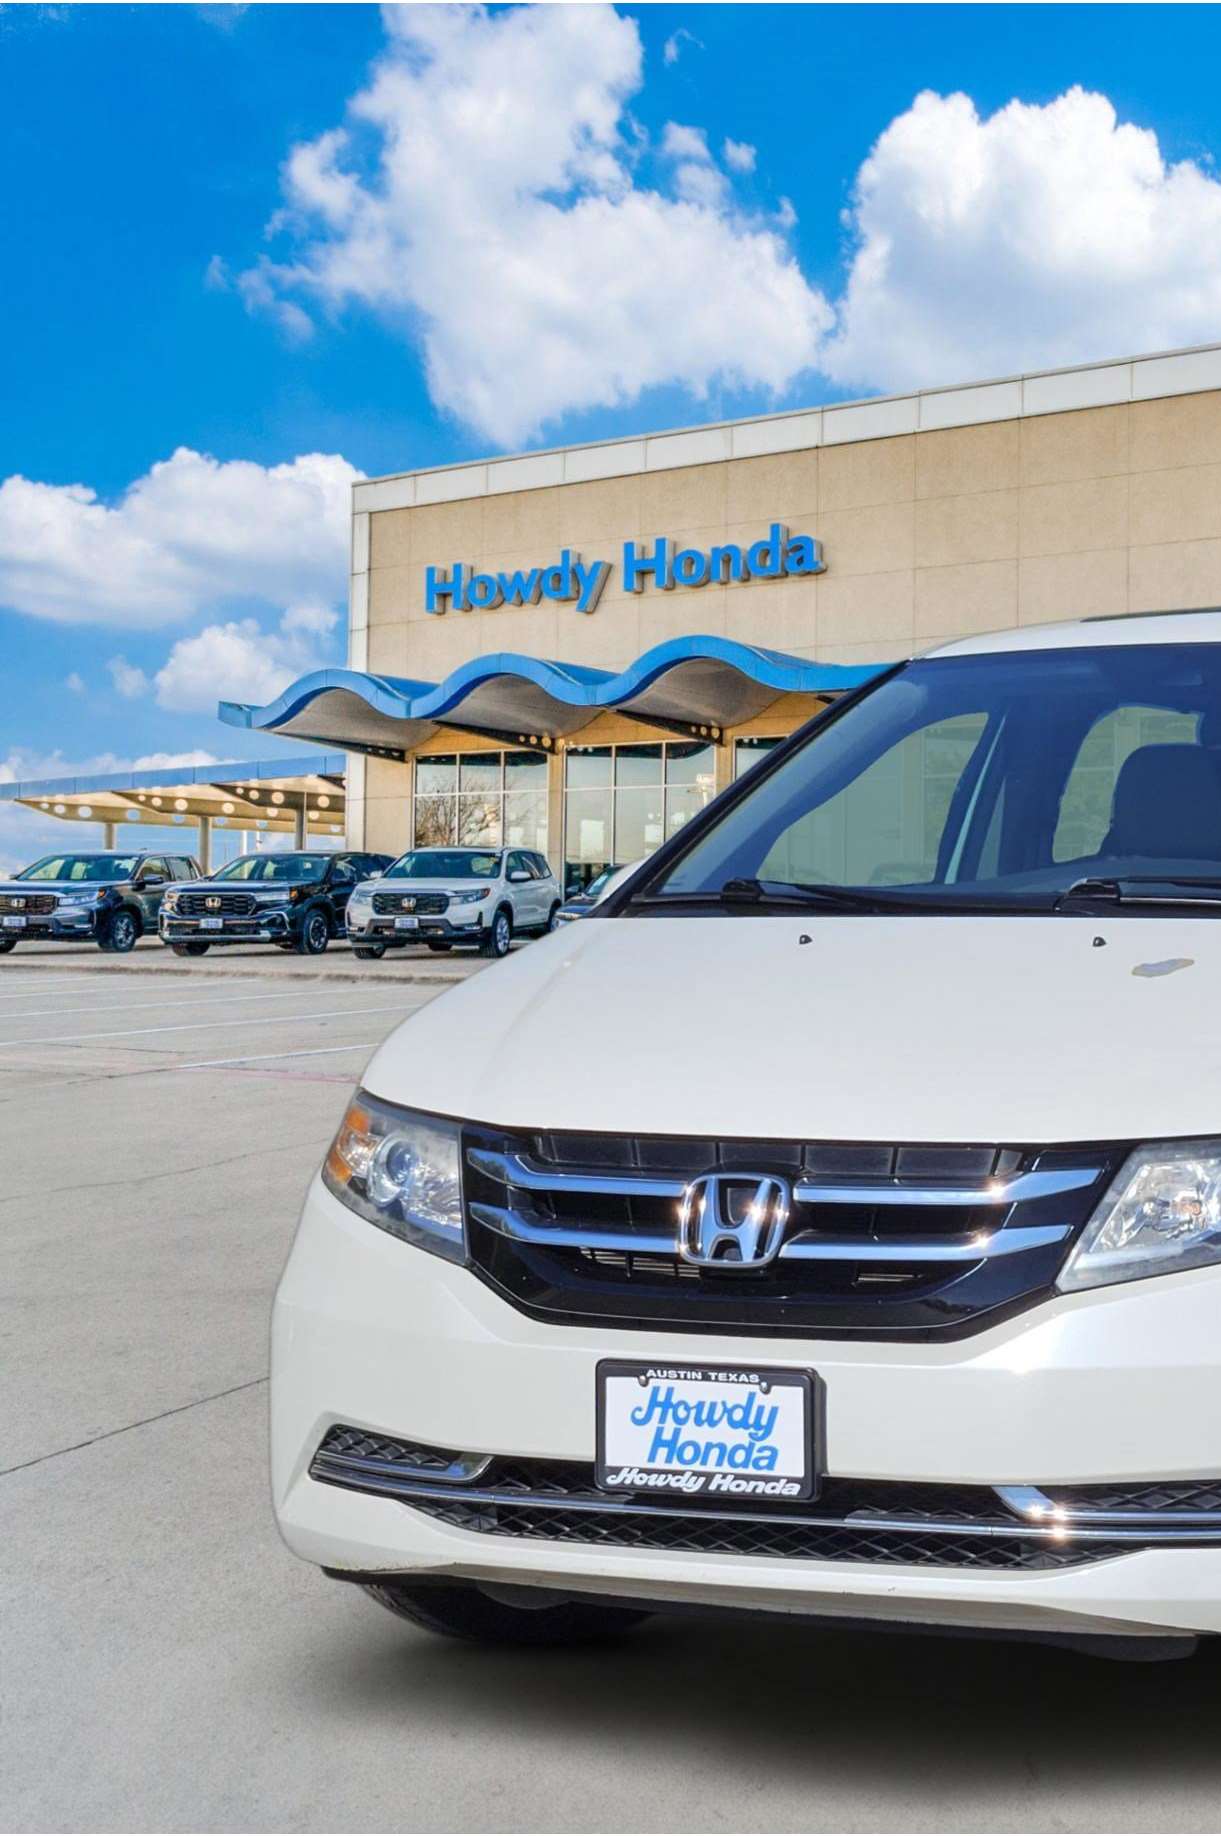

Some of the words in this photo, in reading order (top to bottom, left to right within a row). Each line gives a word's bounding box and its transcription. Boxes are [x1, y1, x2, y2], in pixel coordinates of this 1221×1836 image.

[425, 549, 612, 615] Howdy
[622, 522, 827, 595] Honda
[646, 1368, 703, 1381] AUSTIN
[707, 1371, 760, 1384] TEXAS
[630, 1385, 779, 1442] Howdy
[647, 1426, 779, 1471] Honda
[606, 1466, 706, 1493] Howdy
[708, 1473, 801, 1496] Honda
